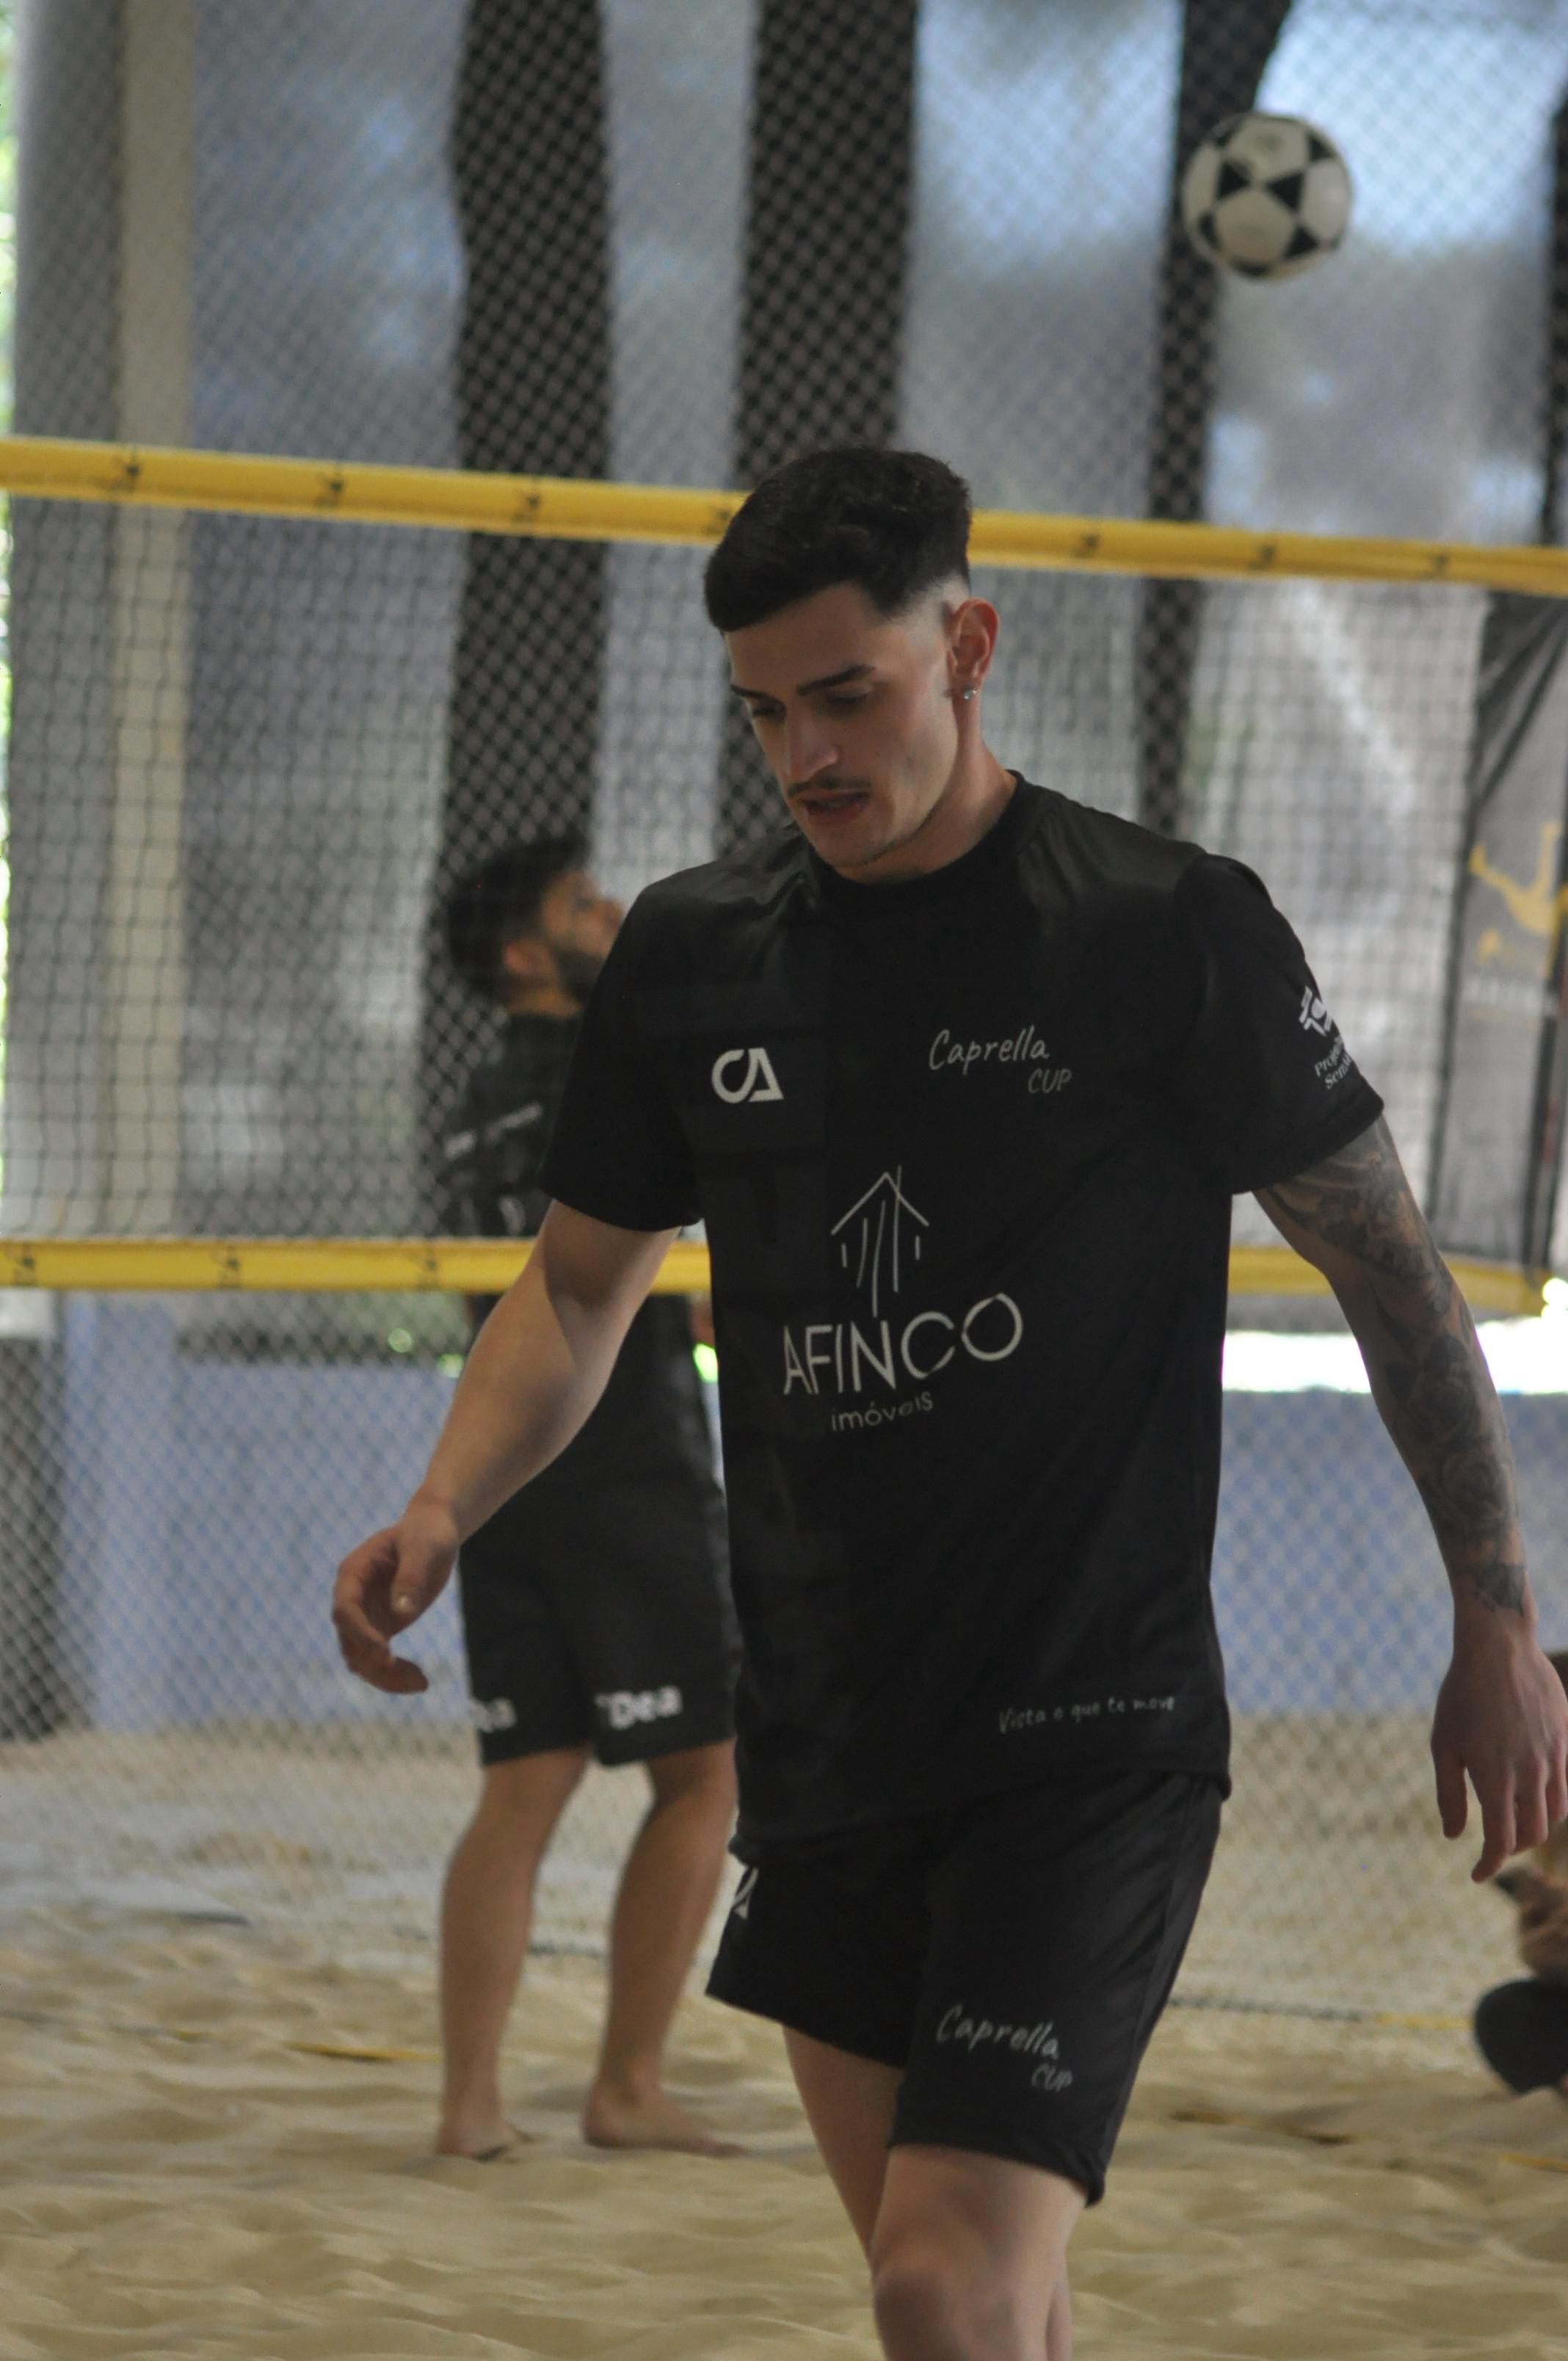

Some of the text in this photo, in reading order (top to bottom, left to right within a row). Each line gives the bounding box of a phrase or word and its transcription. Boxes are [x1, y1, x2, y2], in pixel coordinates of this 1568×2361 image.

[929, 1025, 1051, 1075] Caprella
[1028, 1067, 1072, 1094] CUP
[783, 1293, 1023, 1395] AFINCO
[830, 1391, 934, 1432] imóveis
[936, 2003, 1060, 2061] Caprella
